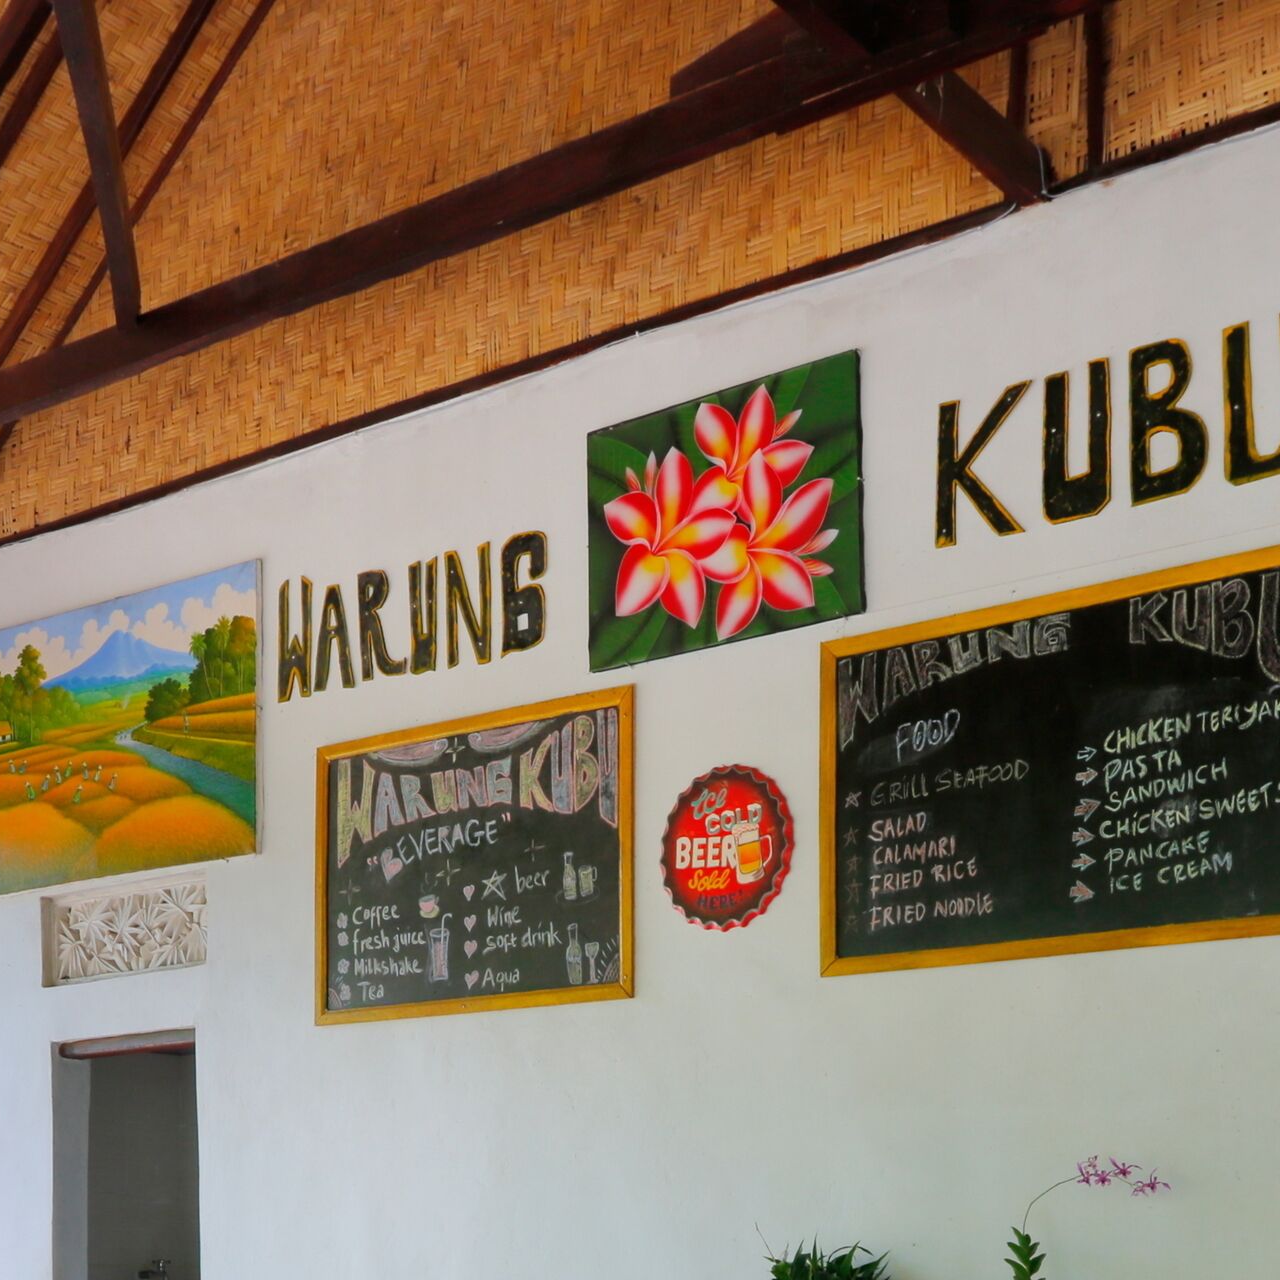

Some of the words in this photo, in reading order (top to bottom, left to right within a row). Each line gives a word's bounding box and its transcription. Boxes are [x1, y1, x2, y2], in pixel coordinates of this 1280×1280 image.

[277, 530, 549, 704] WARUNG
[837, 612, 1071, 752] WARUNG
[895, 708, 961, 763] FOOD
[1103, 712, 1192, 754] CHICKEN
[337, 756, 513, 869] WARUNG
[519, 707, 619, 829] KUBU
[934, 759, 1030, 793] SEAFOOD
[1102, 749, 1182, 793] PASTA
[1104, 757, 1228, 812] SANDWICH
[1198, 781, 1273, 820] SWEET
[705, 803, 762, 835] COLD
[868, 811, 928, 842] SALAD
[676, 834, 737, 869] BEER
[872, 835, 957, 866] CALAMARI
[1104, 830, 1210, 874] PANCAKE
[515, 866, 551, 894] beer
[688, 868, 731, 892] Sold
[869, 869, 924, 900] FRIED
[930, 857, 979, 883] RICE
[1109, 873, 1143, 894] ICE
[1157, 851, 1233, 884] CREAM
[352, 904, 401, 928] Coffee
[487, 905, 522, 928] Wine
[868, 904, 926, 932] FRIED
[934, 891, 994, 919] NOODLE
[353, 928, 390, 955] fresh
[393, 928, 427, 953] juice
[520, 921, 563, 948] drink
[354, 957, 424, 977] Milkshake
[481, 966, 521, 992] Aqua
[357, 980, 385, 1002] Tea
